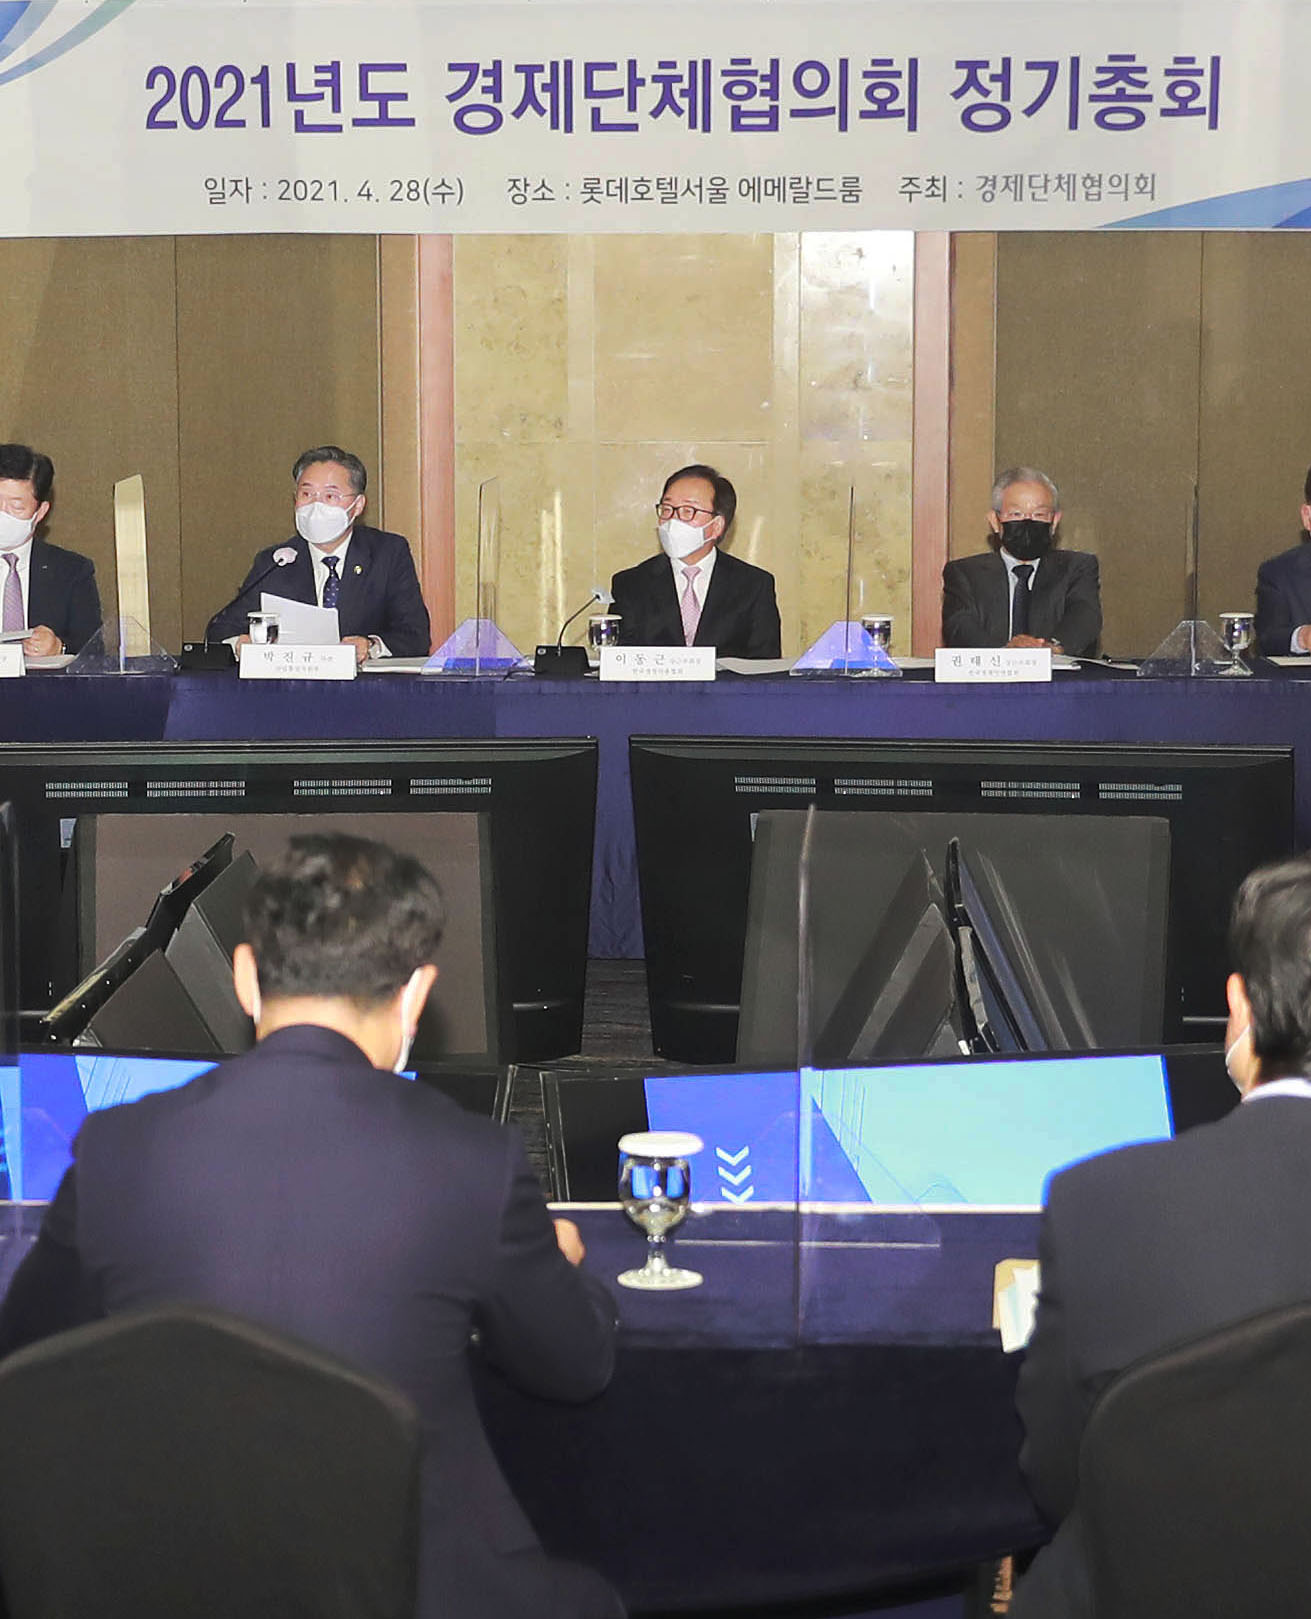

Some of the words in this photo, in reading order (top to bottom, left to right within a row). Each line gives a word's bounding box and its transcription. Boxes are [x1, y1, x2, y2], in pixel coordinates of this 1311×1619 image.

[145, 60, 416, 134] 2021년도
[445, 57, 919, 136] 경제단체협의회
[949, 54, 1221, 133] 정기총회
[204, 176, 253, 205] 일자
[277, 179, 349, 203] 2021.
[357, 180, 380, 203] 4.
[390, 178, 464, 205] 28(수)
[507, 177, 556, 205] 장소
[580, 176, 730, 205] 롯데호텔서울
[738, 176, 863, 204] 에메랄드룸
[898, 175, 947, 203] 주최
[974, 172, 1158, 203] 경제단체협의회
